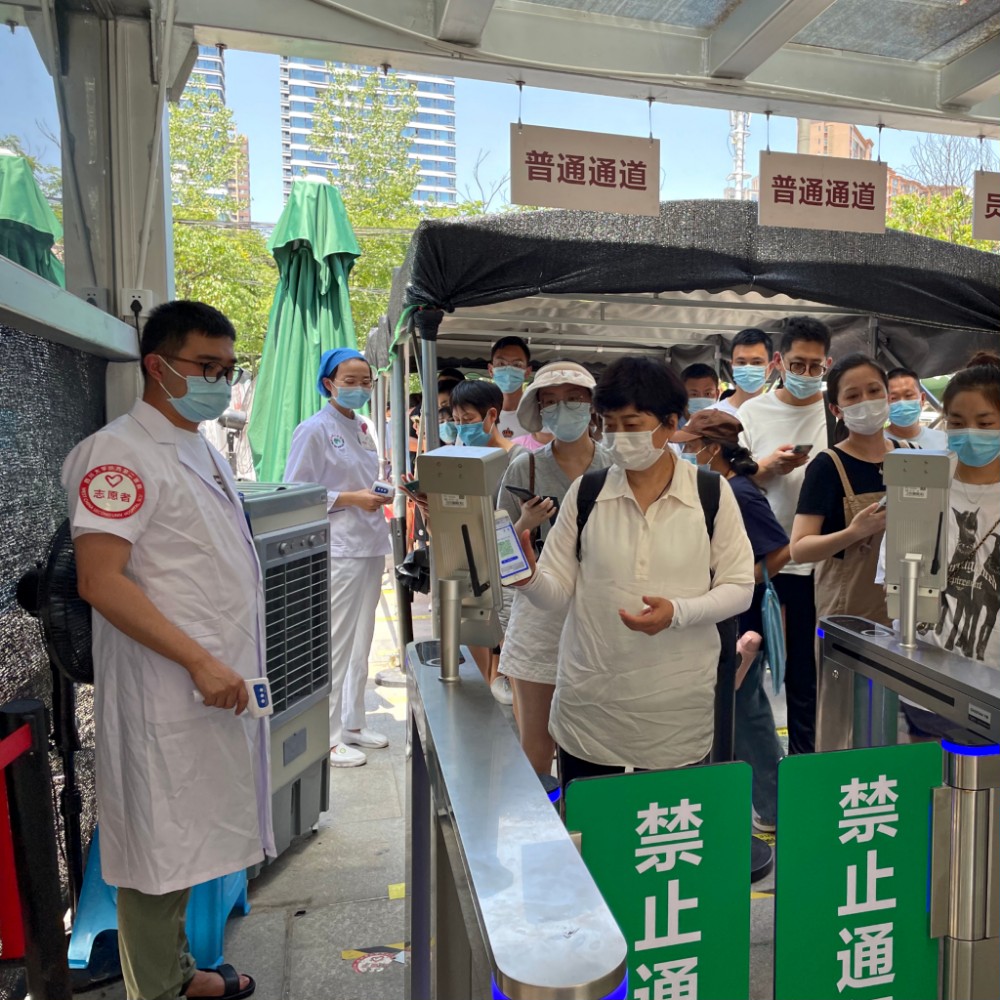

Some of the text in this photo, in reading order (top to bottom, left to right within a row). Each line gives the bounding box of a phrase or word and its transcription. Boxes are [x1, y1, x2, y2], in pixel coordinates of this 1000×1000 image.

[525, 150, 648, 191] 普通通道
[771, 175, 876, 211] 普通通道
[93, 489, 132, 503] 志愿者
[836, 774, 899, 1000] 禁止通
